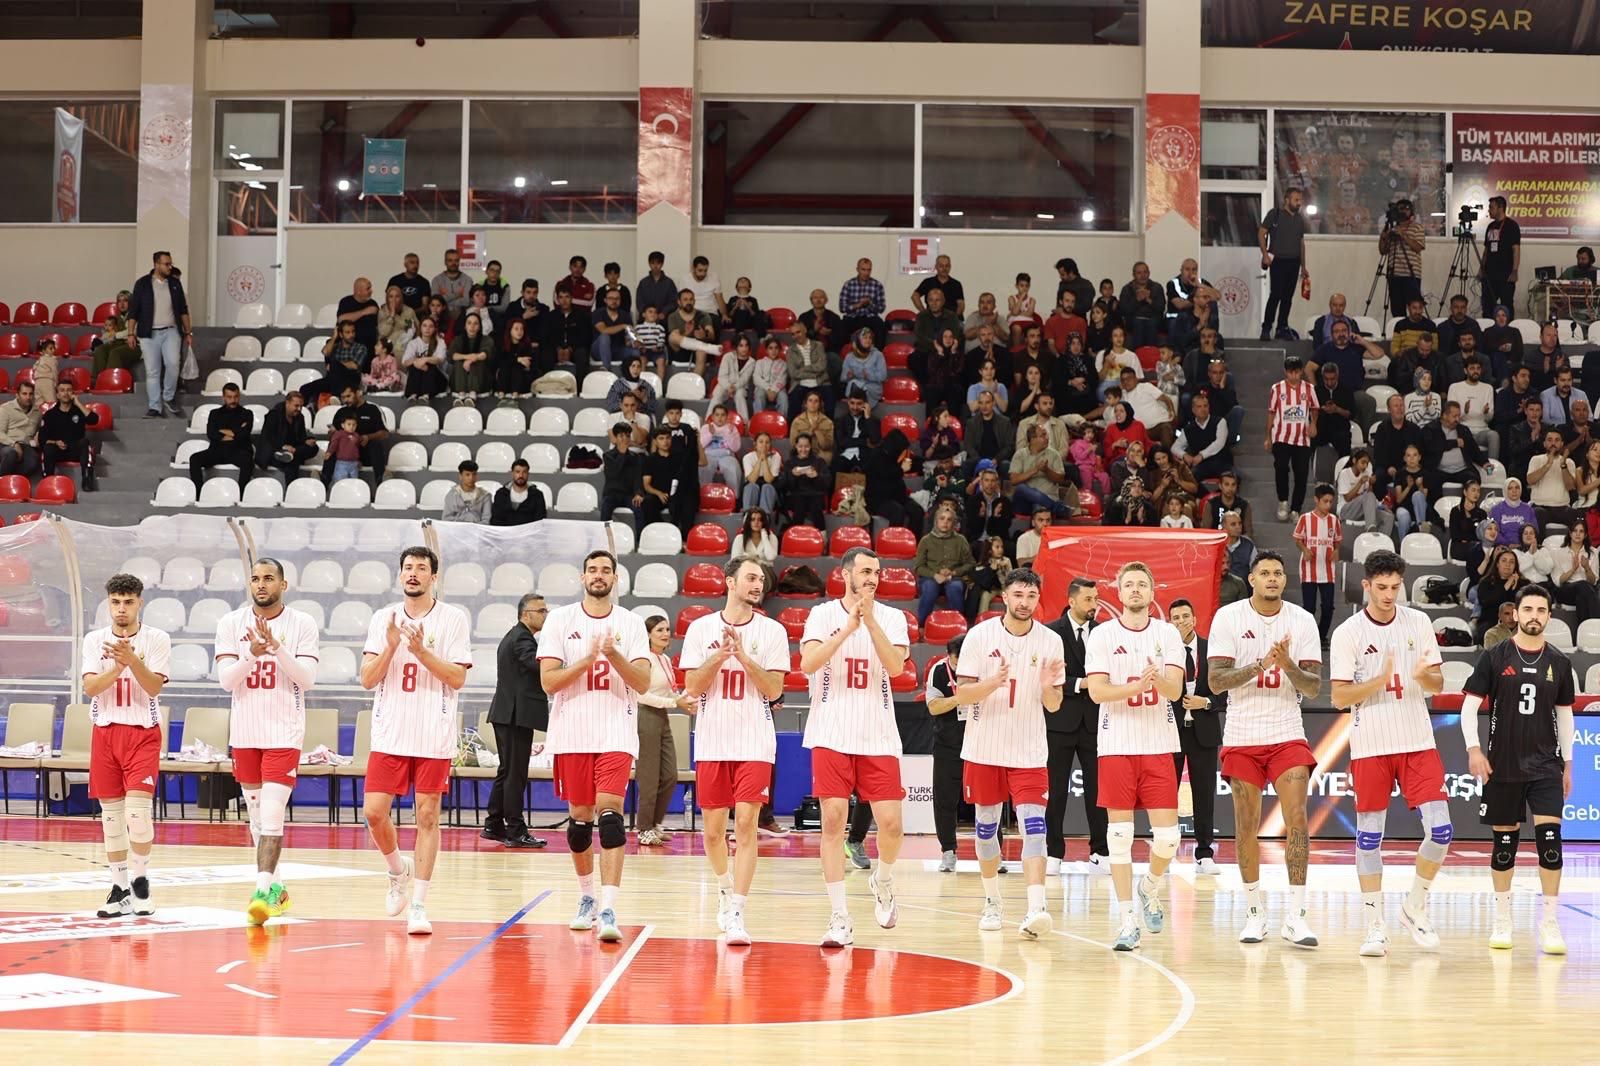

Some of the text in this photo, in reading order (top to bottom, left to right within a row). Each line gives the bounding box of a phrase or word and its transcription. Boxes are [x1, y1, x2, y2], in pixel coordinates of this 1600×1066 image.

[1284, 2, 1533, 35] ZAFERE KOŞAR
[1457, 128, 1490, 145] TÜM
[1461, 148, 1550, 164] BAŞARILAR
[1505, 207, 1543, 218] UTBOL
[456, 234, 476, 260] E
[910, 239, 928, 264] F
[246, 661, 276, 690] 33
[402, 662, 417, 692] 8
[587, 660, 610, 691] 12
[721, 669, 745, 700] 10
[845, 657, 868, 689] 15
[1256, 658, 1281, 689] 13
[1386, 673, 1403, 700] 4
[115, 677, 131, 707] 11
[1009, 679, 1016, 708] 1
[1518, 683, 1537, 715] 3
[1479, 803, 1488, 817] 3
